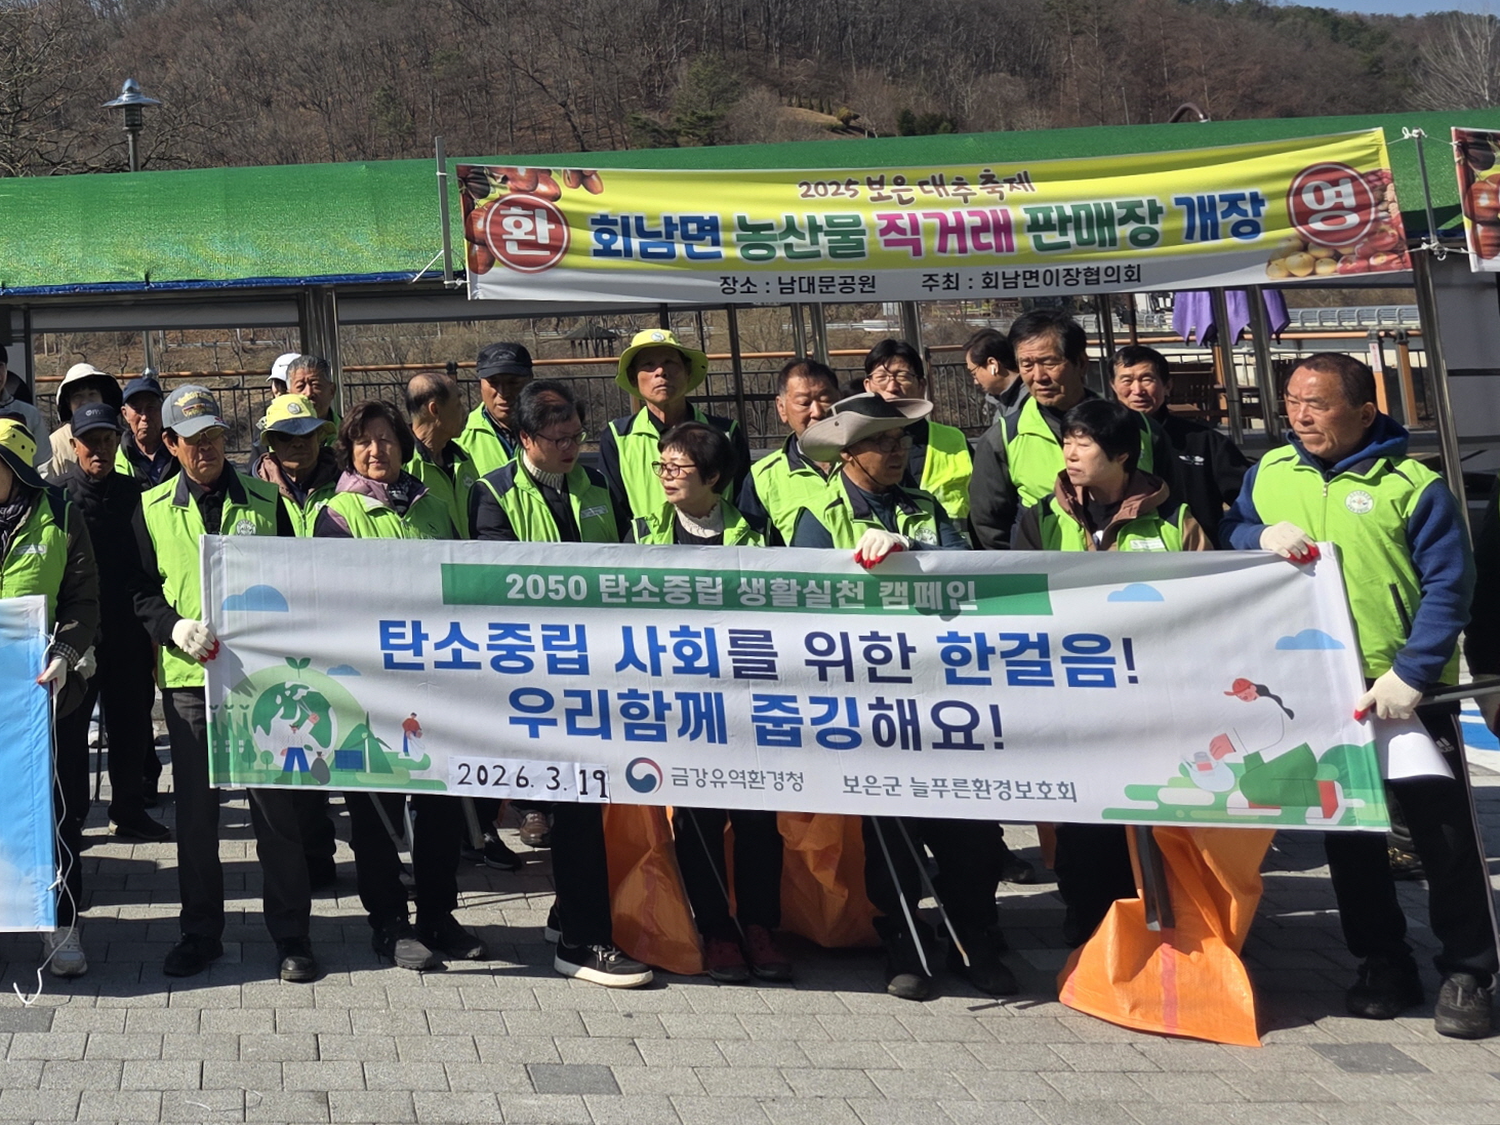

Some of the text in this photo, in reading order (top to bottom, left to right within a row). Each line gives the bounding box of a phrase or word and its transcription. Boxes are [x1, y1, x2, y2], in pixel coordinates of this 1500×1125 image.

[799, 178, 860, 199] 2025
[1301, 179, 1360, 231] 영
[501, 206, 556, 257] 환
[590, 191, 1267, 261] 회남면 농산물 직거래 판매장 개장
[719, 275, 758, 295] 장소
[777, 274, 877, 295] 남대문공원
[921, 272, 960, 292] 주최
[981, 263, 1142, 290] 회남면이장협의회
[506, 573, 979, 611] 2050 탄소중립 생활실천 캠페인
[378, 619, 1140, 688] 탄소중립 사회를 위한 한걸음!
[508, 686, 1005, 752] 우리함께 줍깅해요!
[670, 765, 1078, 803] 금강유역환경청 보은군 늘푸른환경보호회
